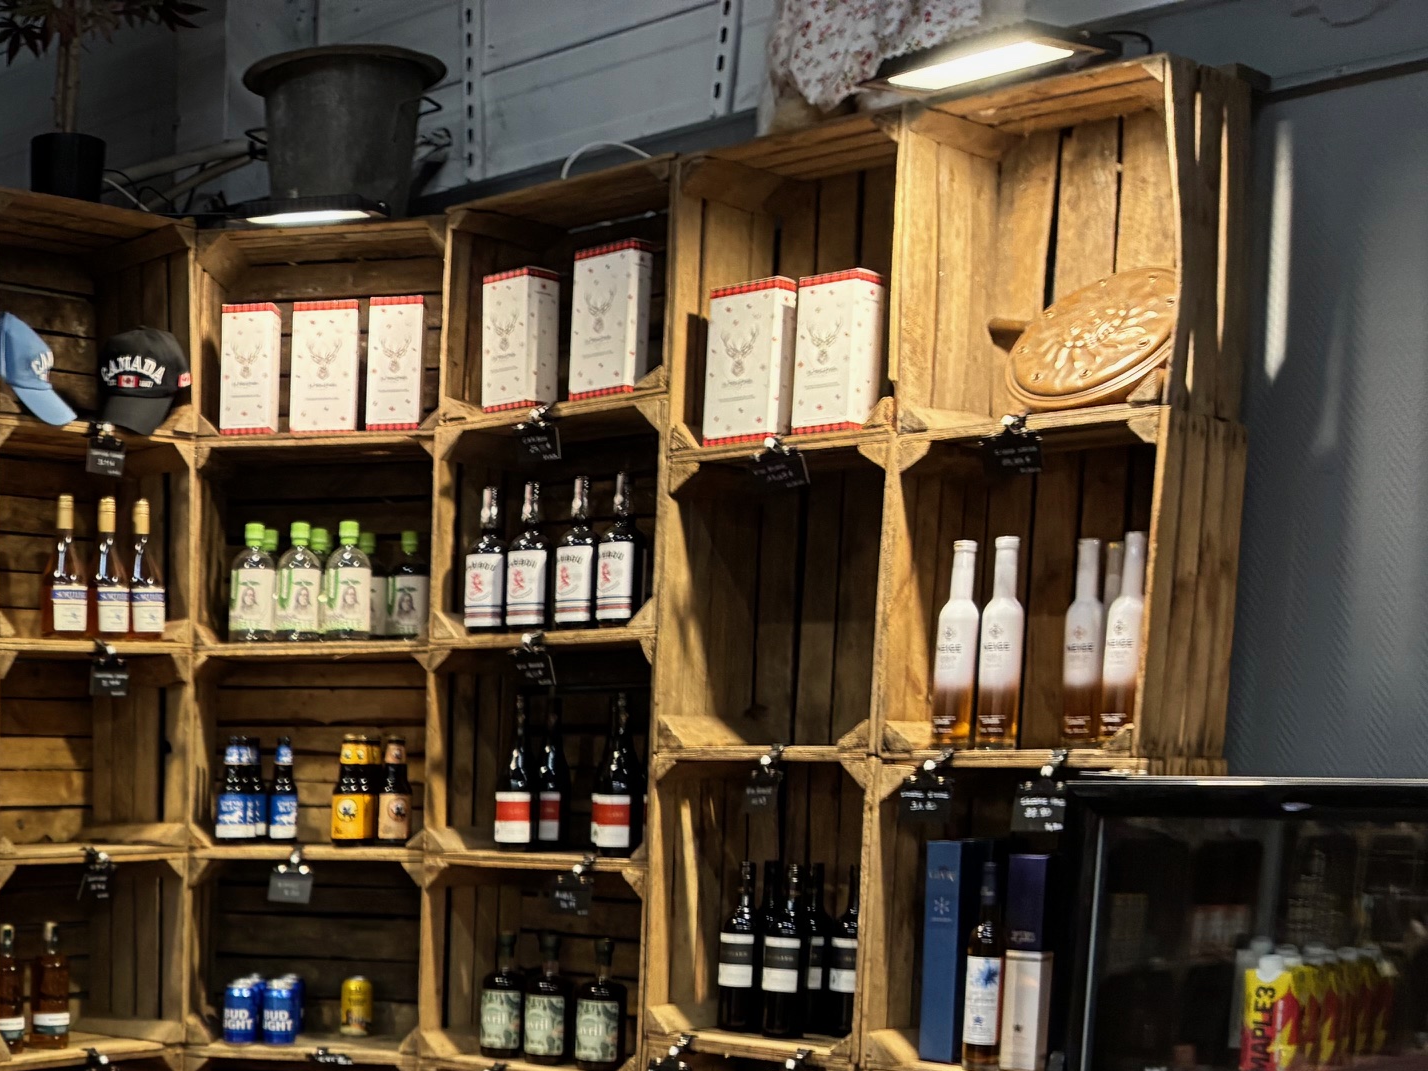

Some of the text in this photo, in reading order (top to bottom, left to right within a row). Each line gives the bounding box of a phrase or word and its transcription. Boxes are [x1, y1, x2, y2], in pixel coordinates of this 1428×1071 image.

[101, 355, 166, 385] CANADA
[223, 1008, 249, 1020] BUD
[263, 1008, 289, 1020] BUD
